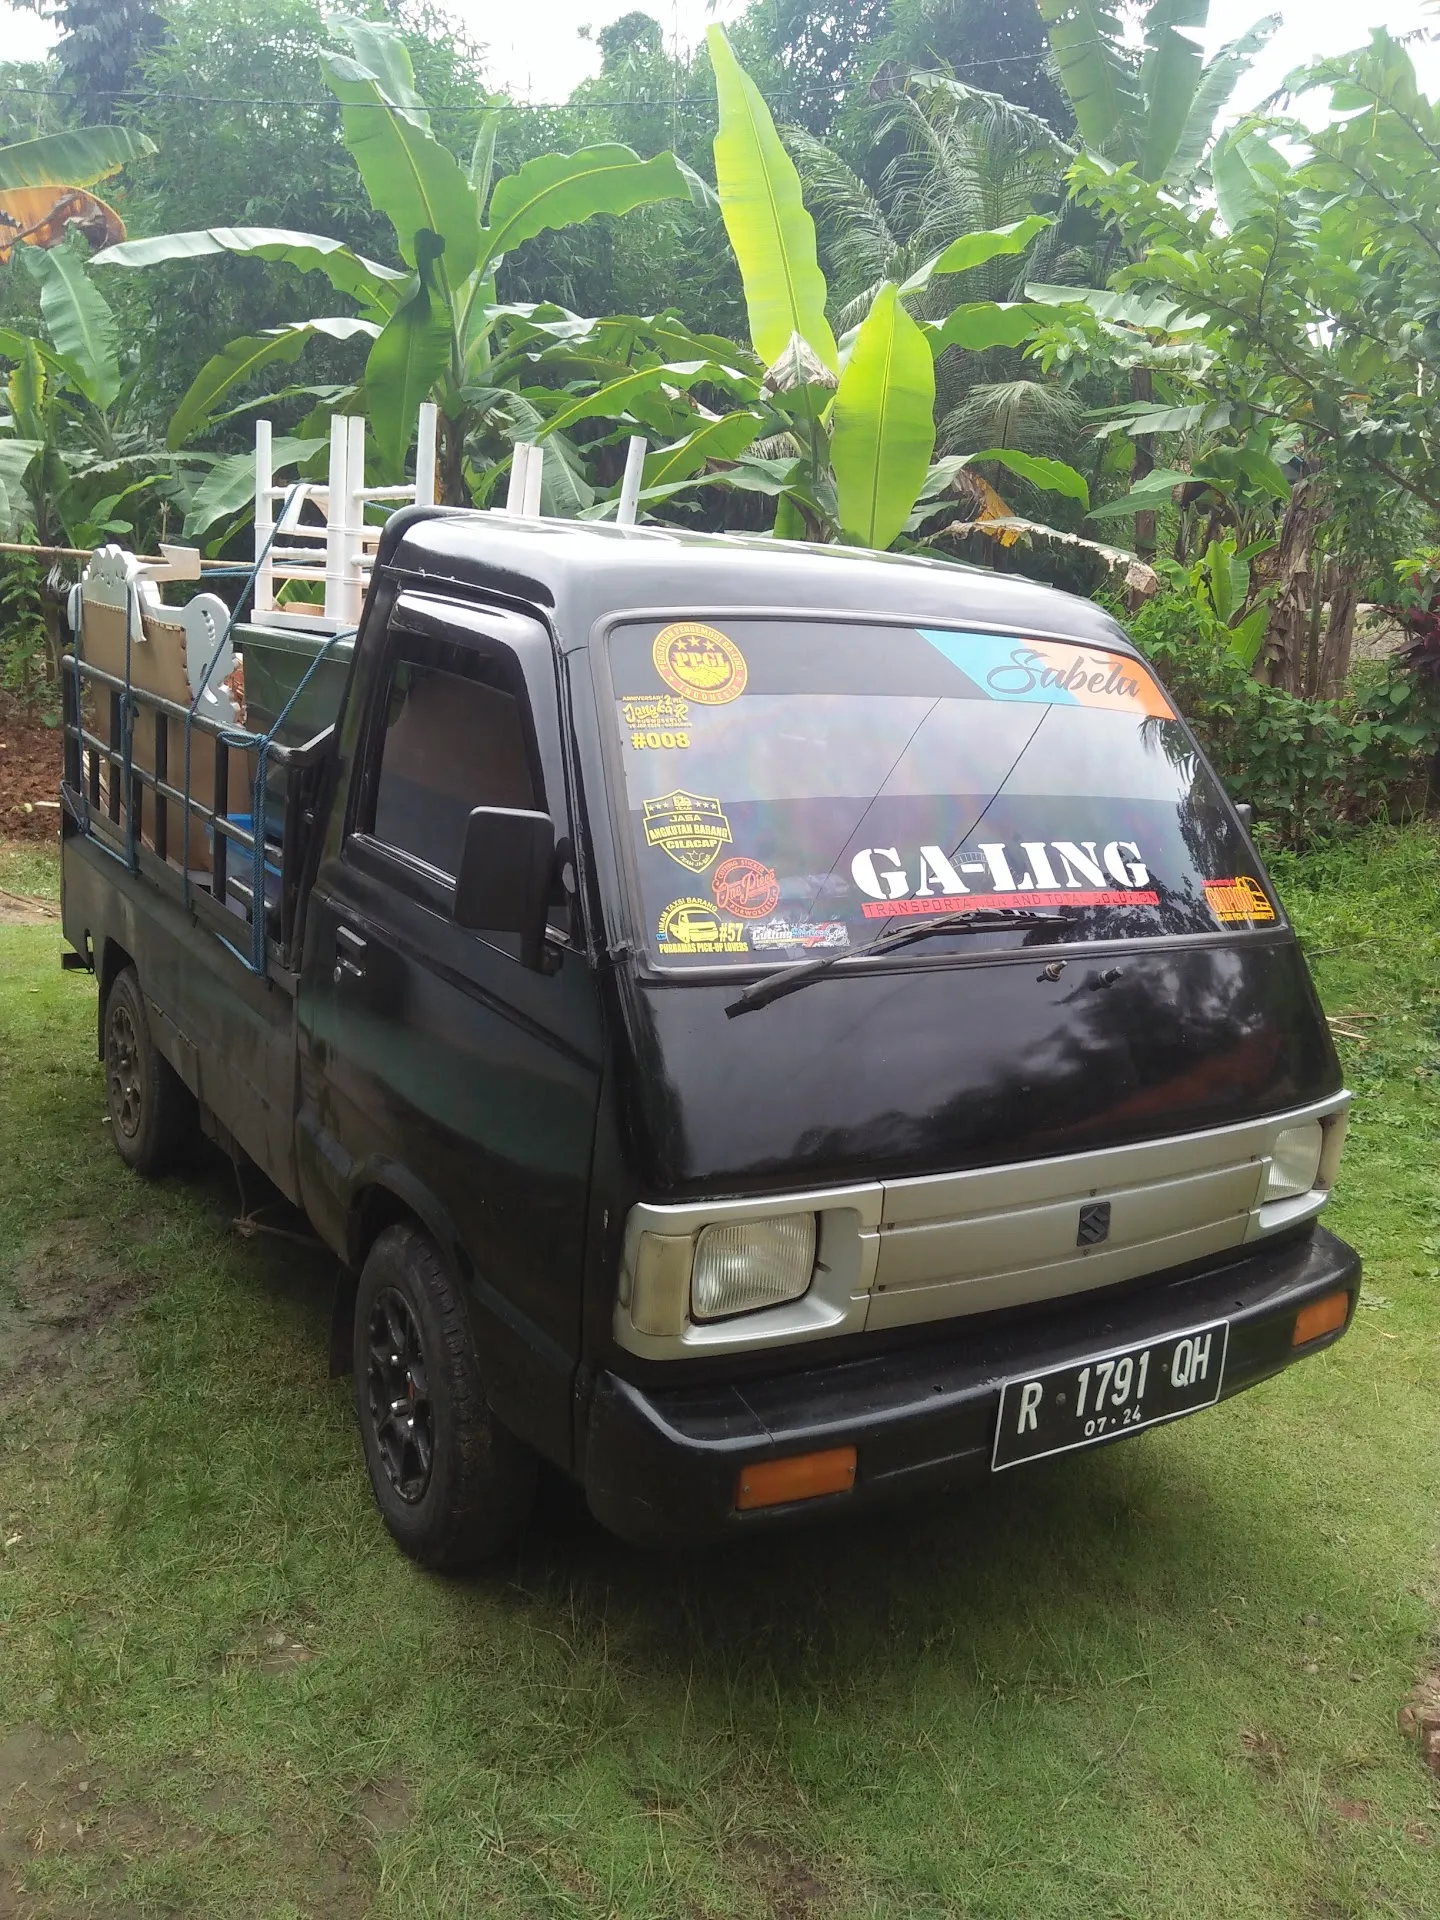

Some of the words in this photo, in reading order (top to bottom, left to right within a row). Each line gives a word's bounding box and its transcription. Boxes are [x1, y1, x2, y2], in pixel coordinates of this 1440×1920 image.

[672, 651, 727, 667] PPGI
[986, 648, 1141, 699] Sabela
[680, 685, 740, 702] INDONESIA
[630, 732, 691, 749] #008
[669, 814, 702, 822] JASA
[648, 824, 693, 841] ANGKUTAN
[693, 824, 728, 839] BARANG
[665, 839, 718, 849] CILACAP
[717, 860, 739, 879] CUTTING
[740, 859, 765, 874] STICKER
[850, 840, 1152, 901] GA-LING
[685, 897, 719, 913] BARANG
[729, 896, 776, 917] PURWOKERTO
[864, 896, 1007, 917] TRANSPORTATON
[1012, 893, 1042, 905] AND
[719, 921, 744, 943] #57
[696, 941, 724, 953] PICK-UP
[724, 941, 749, 953] LOVERS
[1017, 1381, 1043, 1435] R
[1075, 1350, 1151, 1418] 1791
[1170, 1333, 1213, 1389] QH
